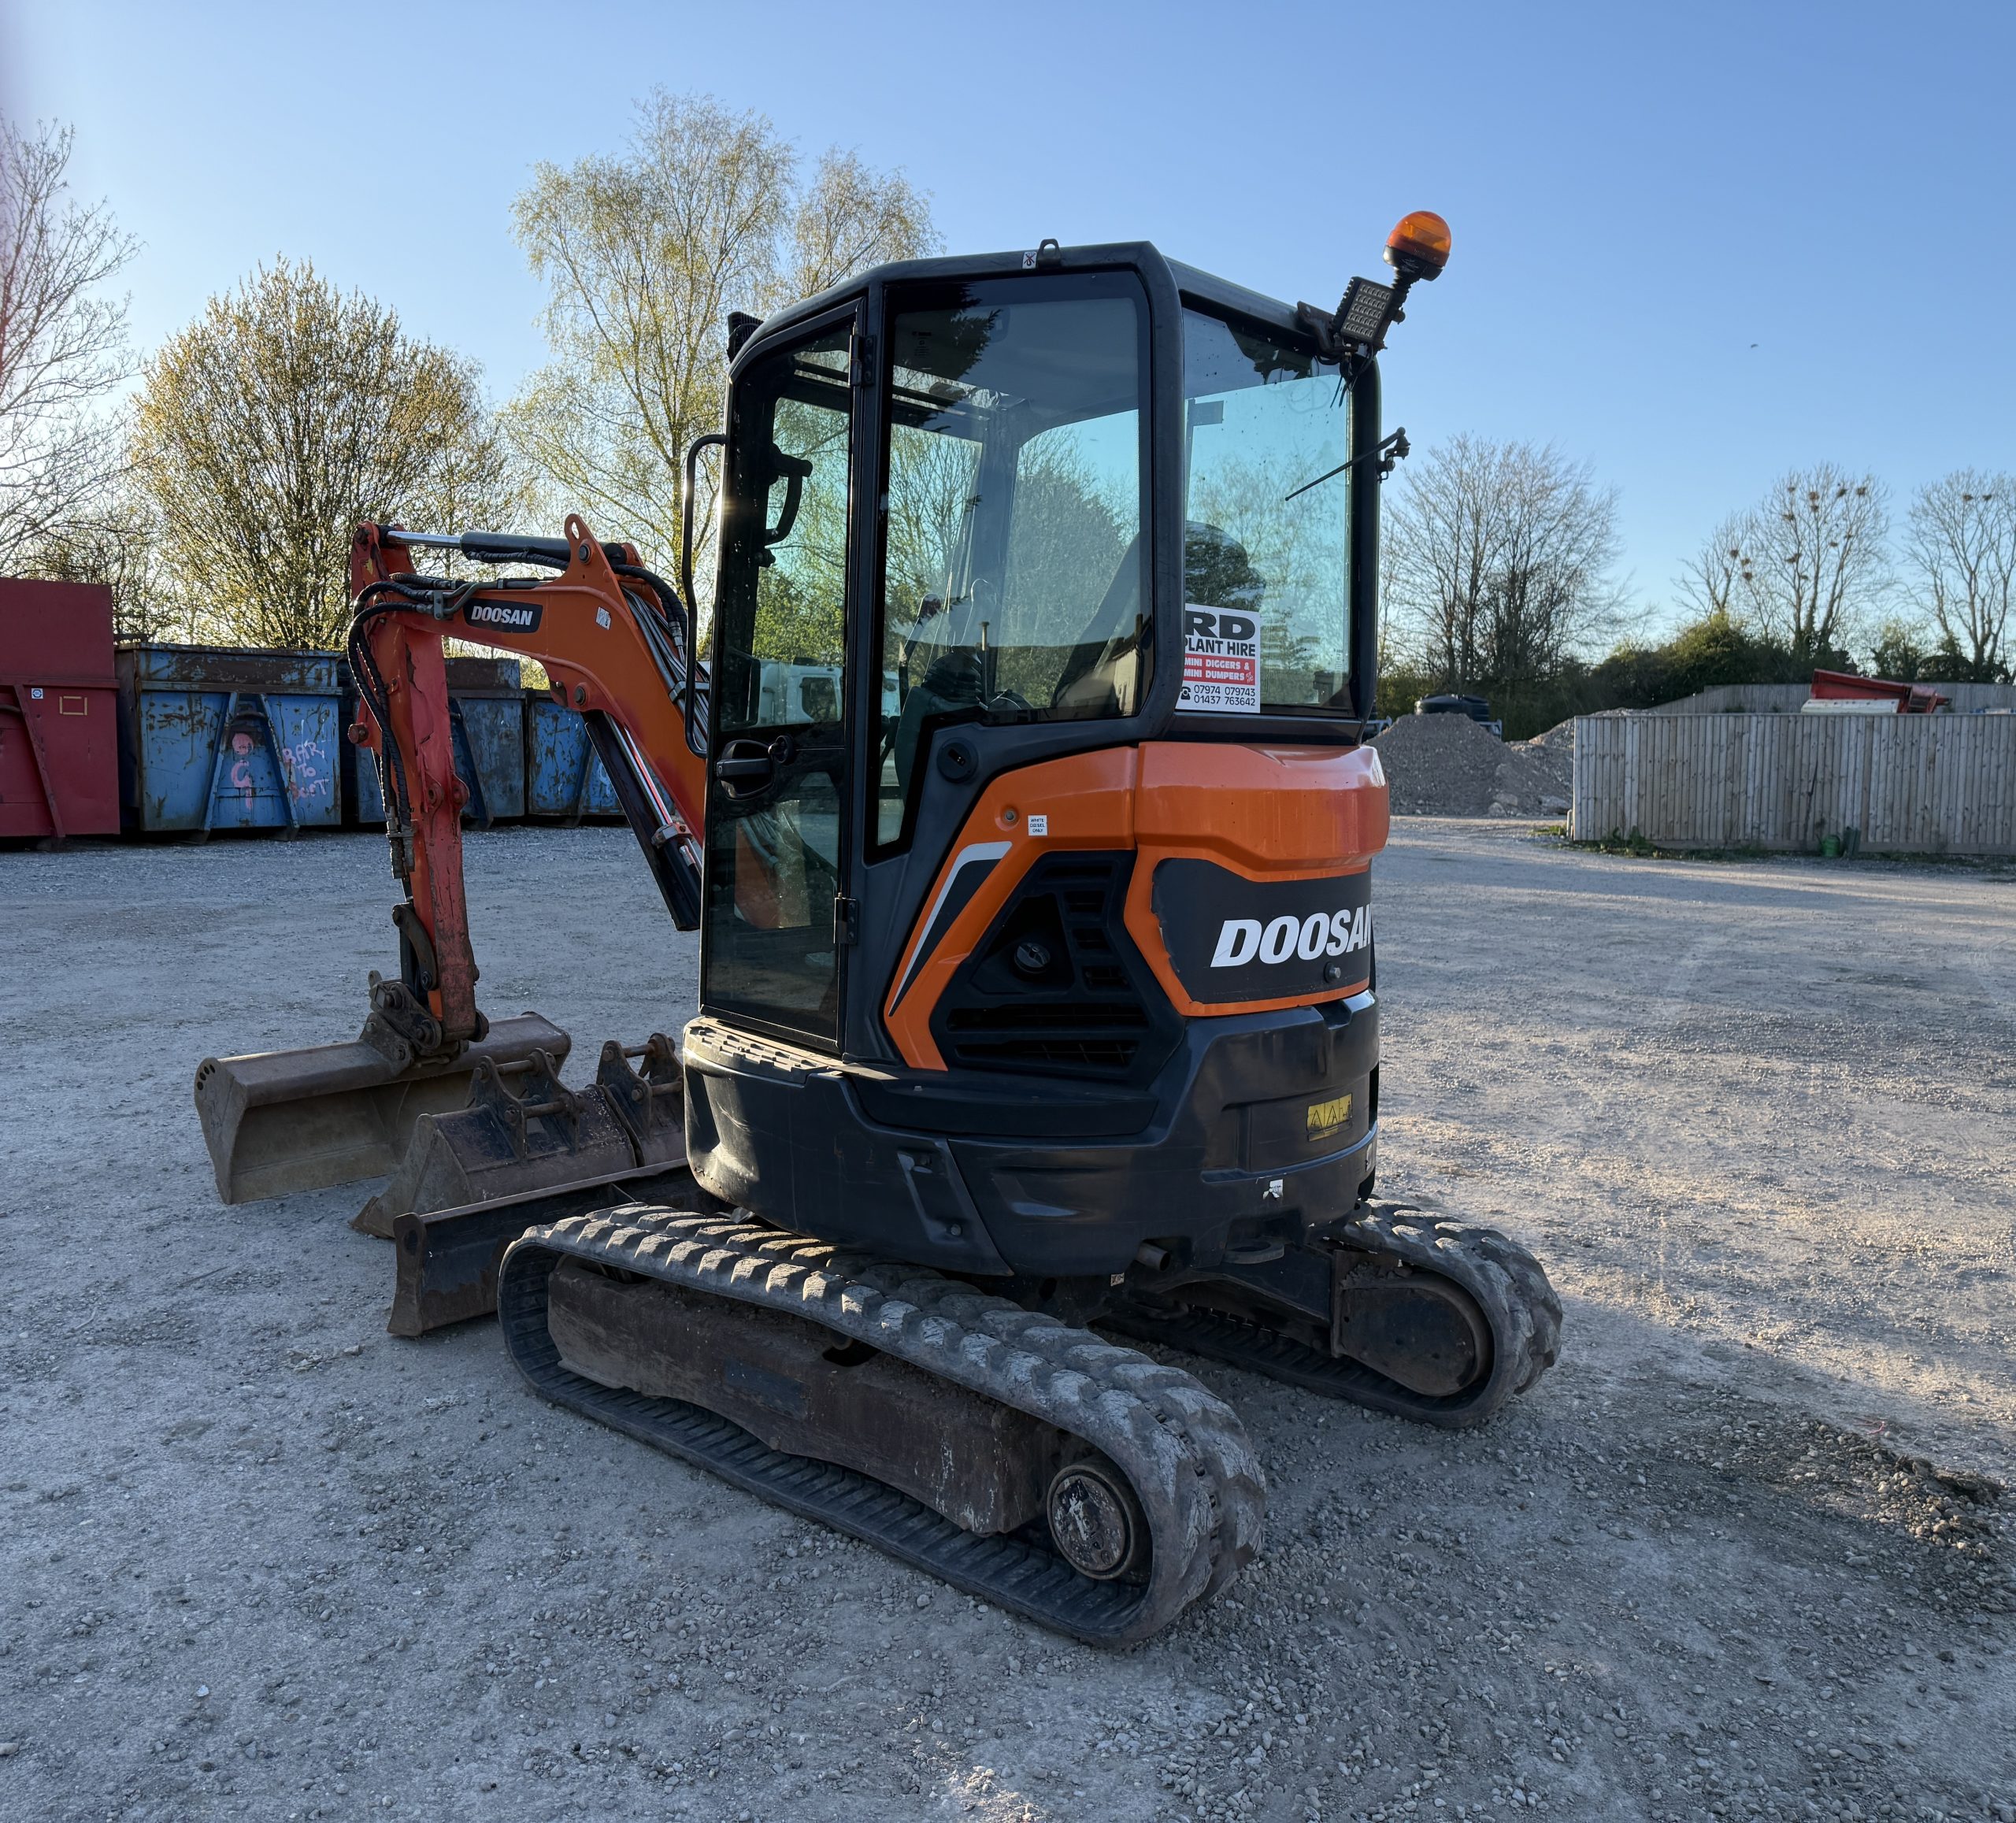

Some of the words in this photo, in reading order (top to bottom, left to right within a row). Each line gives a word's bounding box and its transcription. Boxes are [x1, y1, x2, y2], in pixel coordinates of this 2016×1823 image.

[471, 606, 532, 626] DOOSAN
[1185, 610, 1255, 641] RD
[1227, 641, 1255, 657] HIRE
[1184, 658, 1203, 667] MINI
[1206, 659, 1241, 670] DIGGERS
[1184, 668, 1203, 678] MINI
[1205, 670, 1244, 681] DUMPERS
[1194, 684, 1221, 695] 07974
[1225, 687, 1256, 697] 079743
[1194, 695, 1221, 705] 01437
[1225, 696, 1256, 706] 763642
